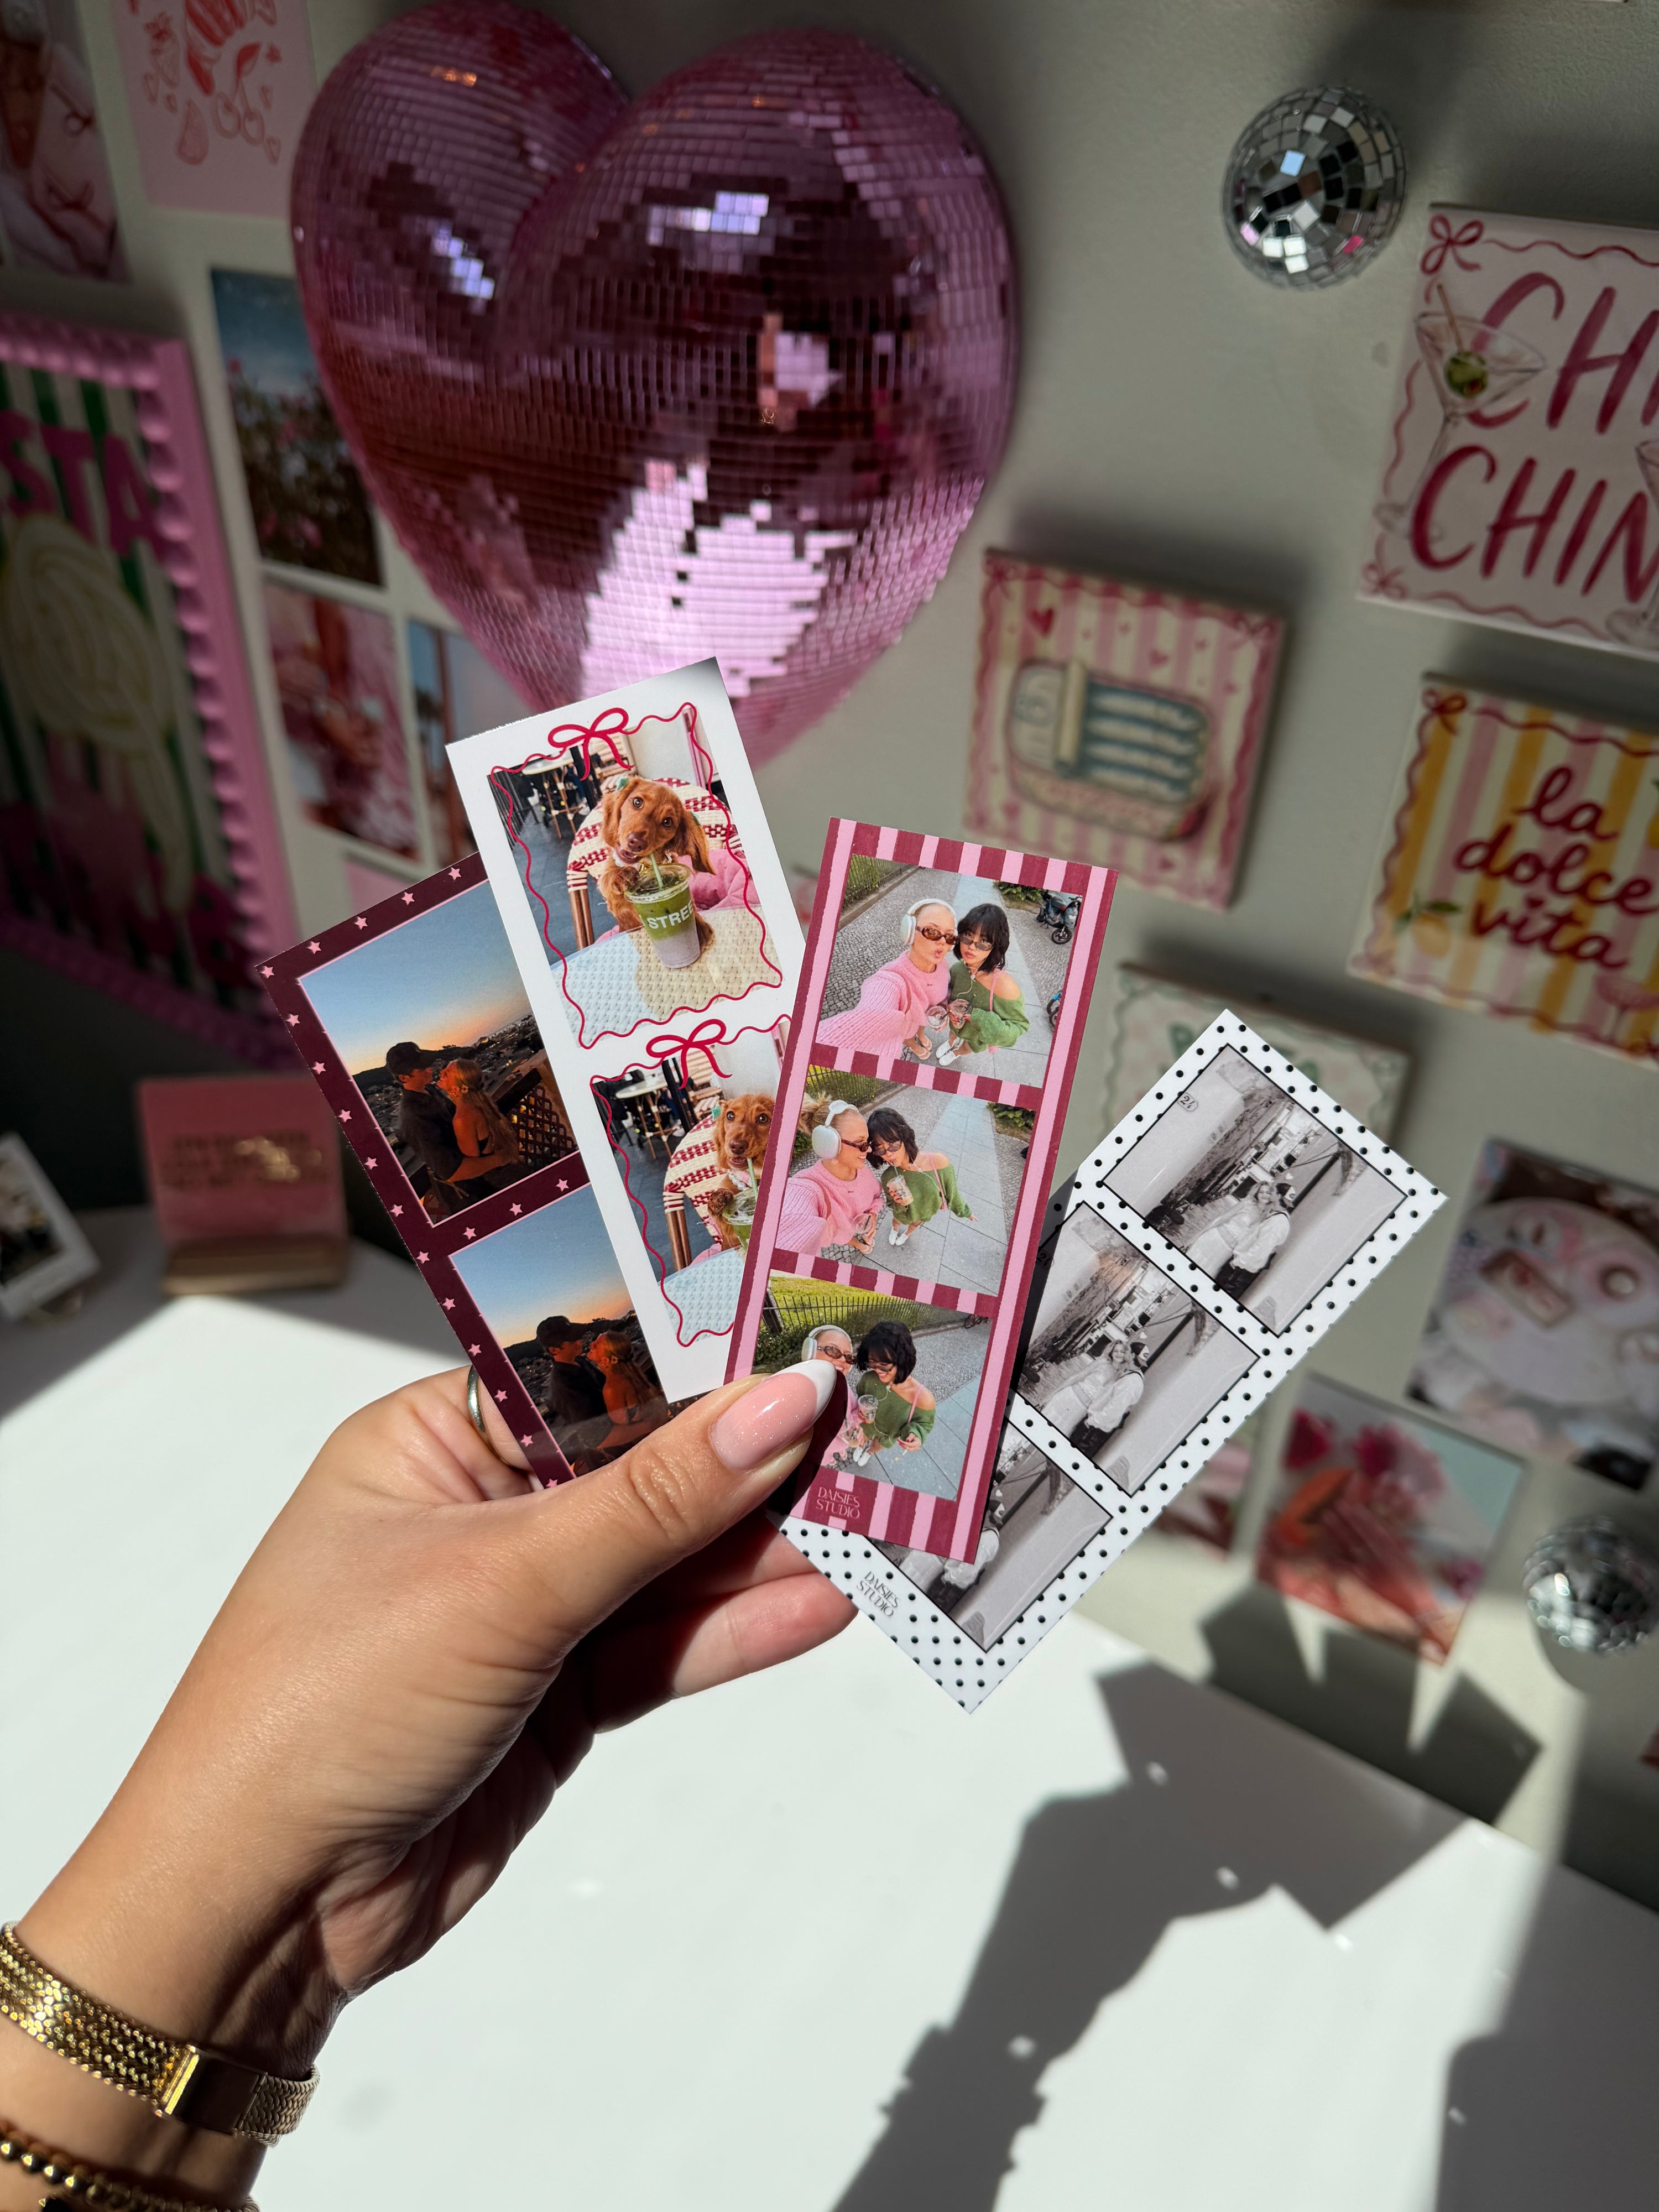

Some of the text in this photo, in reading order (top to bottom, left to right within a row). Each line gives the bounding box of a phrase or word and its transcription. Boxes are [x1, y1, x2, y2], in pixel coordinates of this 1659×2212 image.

[1411, 446, 1659, 603] CHIN
[1511, 766, 1618, 841] la
[1453, 823, 1659, 915] dolce
[1471, 896, 1629, 969] vita
[816, 1499, 860, 1519] STUDIO
[818, 1486, 860, 1508] DAISIES
[857, 1580, 894, 1617] STUDIO
[864, 1571, 898, 1608] DAISIES
